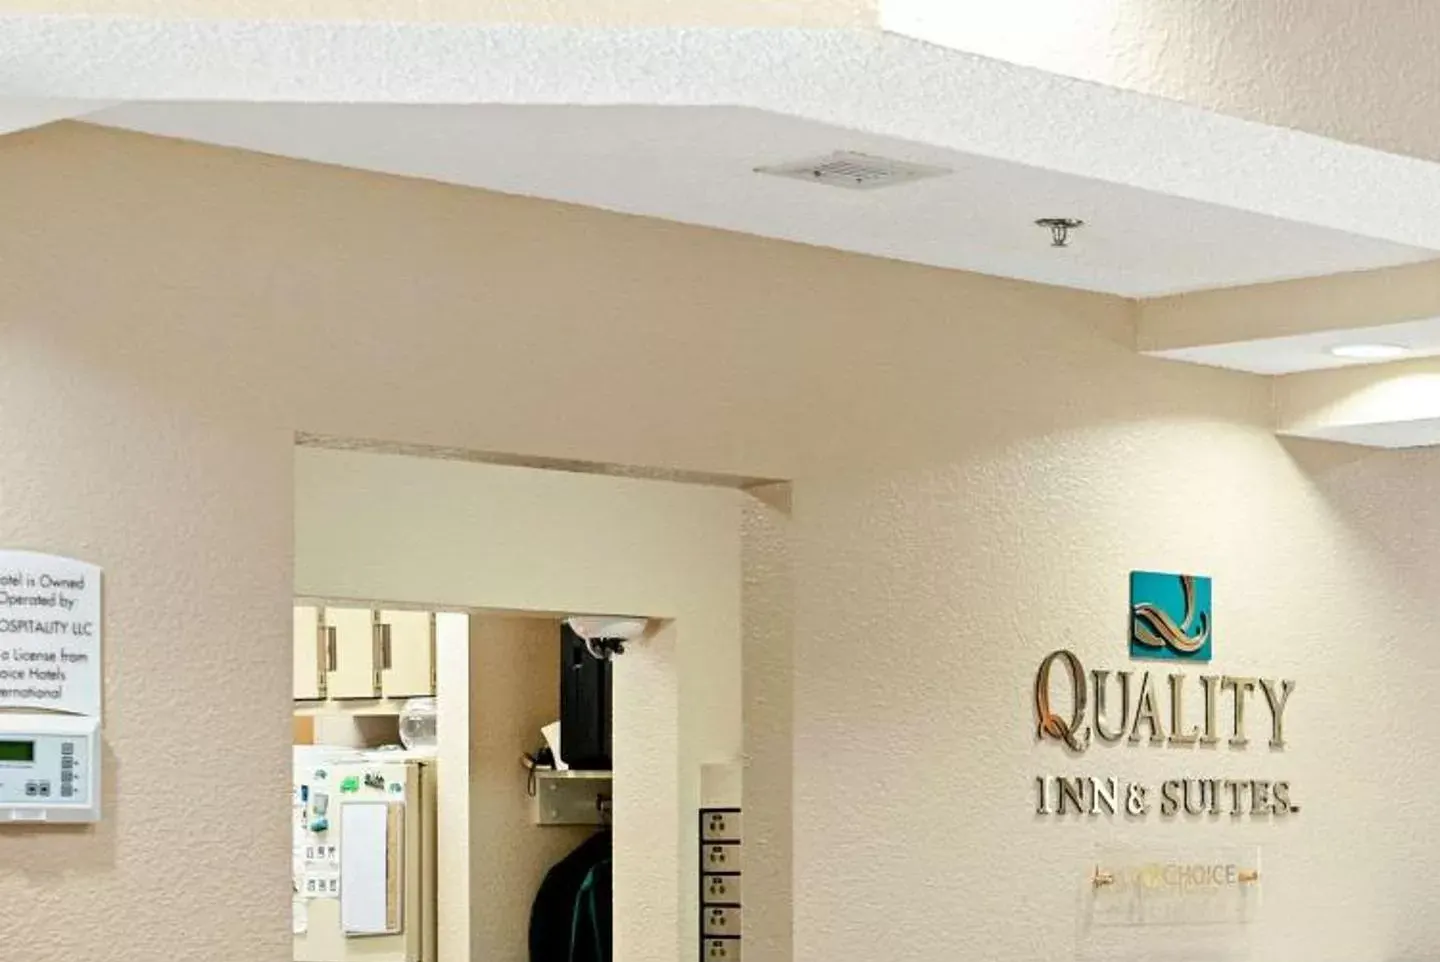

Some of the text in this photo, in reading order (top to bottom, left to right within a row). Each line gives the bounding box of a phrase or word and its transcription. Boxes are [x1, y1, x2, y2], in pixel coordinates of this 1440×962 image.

[40, 573, 84, 590] Owned
[59, 592, 78, 612] by
[72, 621, 92, 636] LLC
[13, 647, 56, 662] License
[60, 647, 88, 664] from
[28, 664, 66, 681] Hotels
[1034, 650, 1295, 752] QUALITY
[1036, 776, 1118, 815] INN
[1126, 781, 1146, 814] &
[1164, 863, 1237, 886] CHOICE
